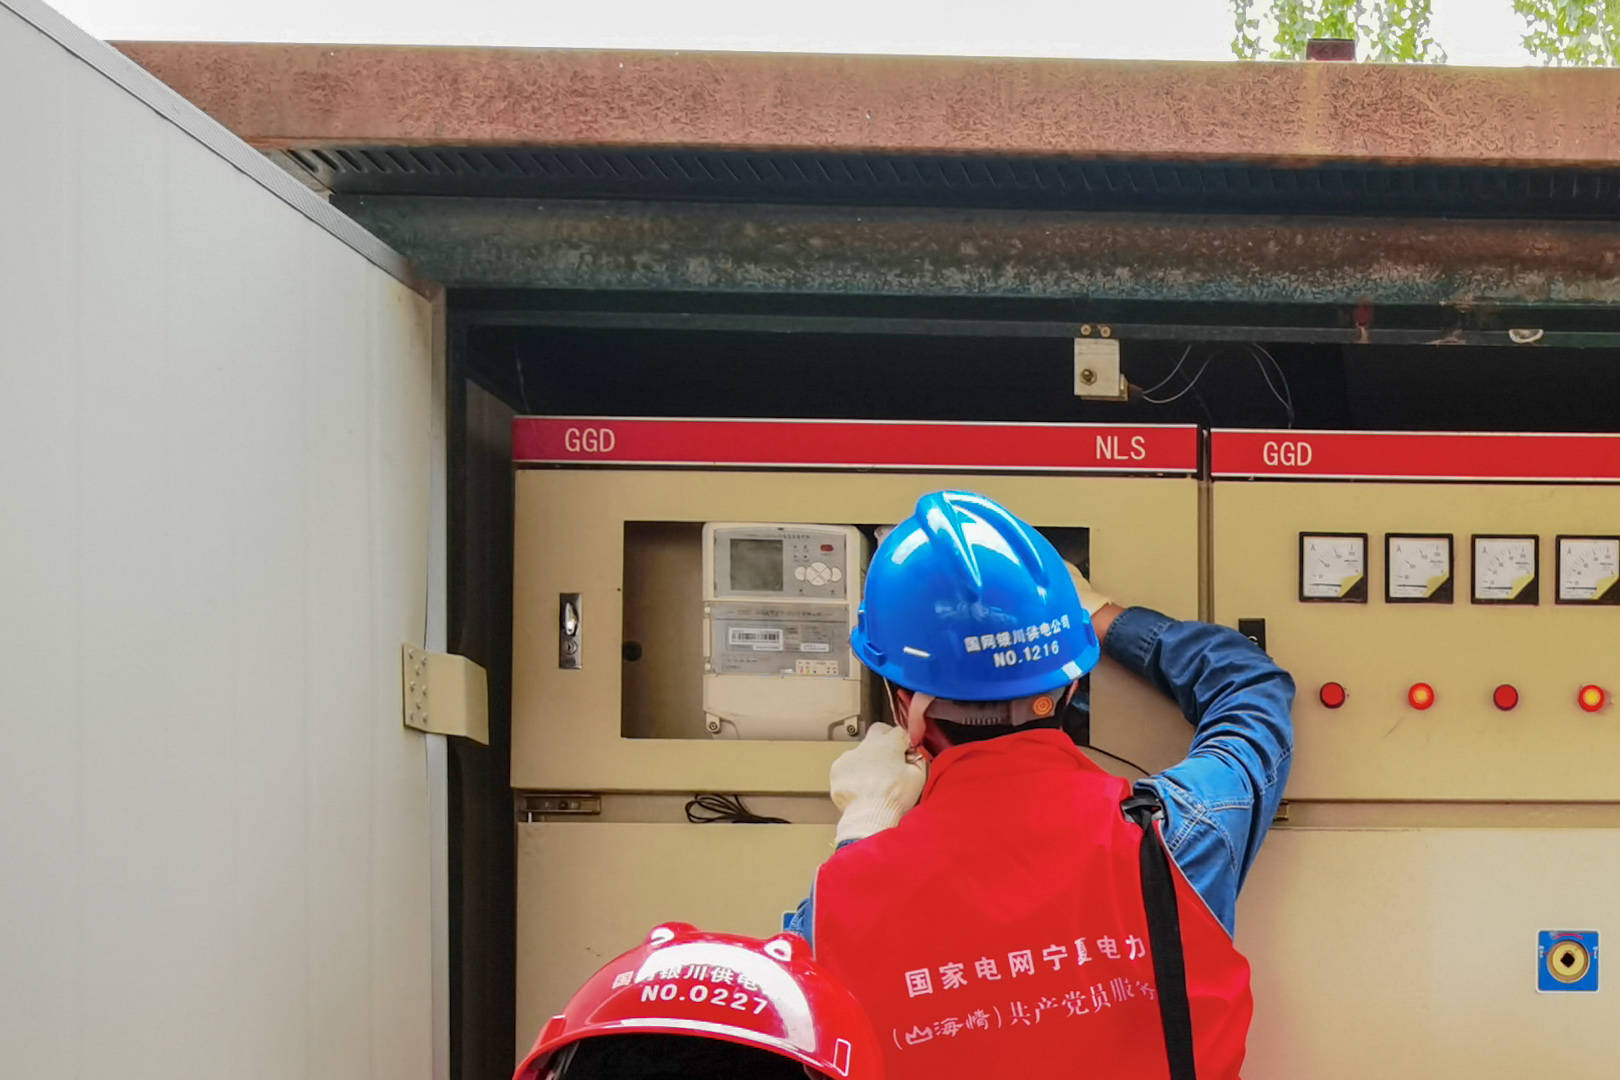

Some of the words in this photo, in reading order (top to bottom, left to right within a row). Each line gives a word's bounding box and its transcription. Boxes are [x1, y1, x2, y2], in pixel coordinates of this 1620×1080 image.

[564, 427, 616, 453] GGD
[1096, 435, 1146, 460] NLS
[1263, 441, 1313, 467] GGD
[963, 613, 1071, 653] 国网银川供电公司
[992, 640, 1060, 668] NO.1216
[904, 934, 1147, 998] 国家电网宁夏电力
[640, 983, 769, 1015] NO.0227
